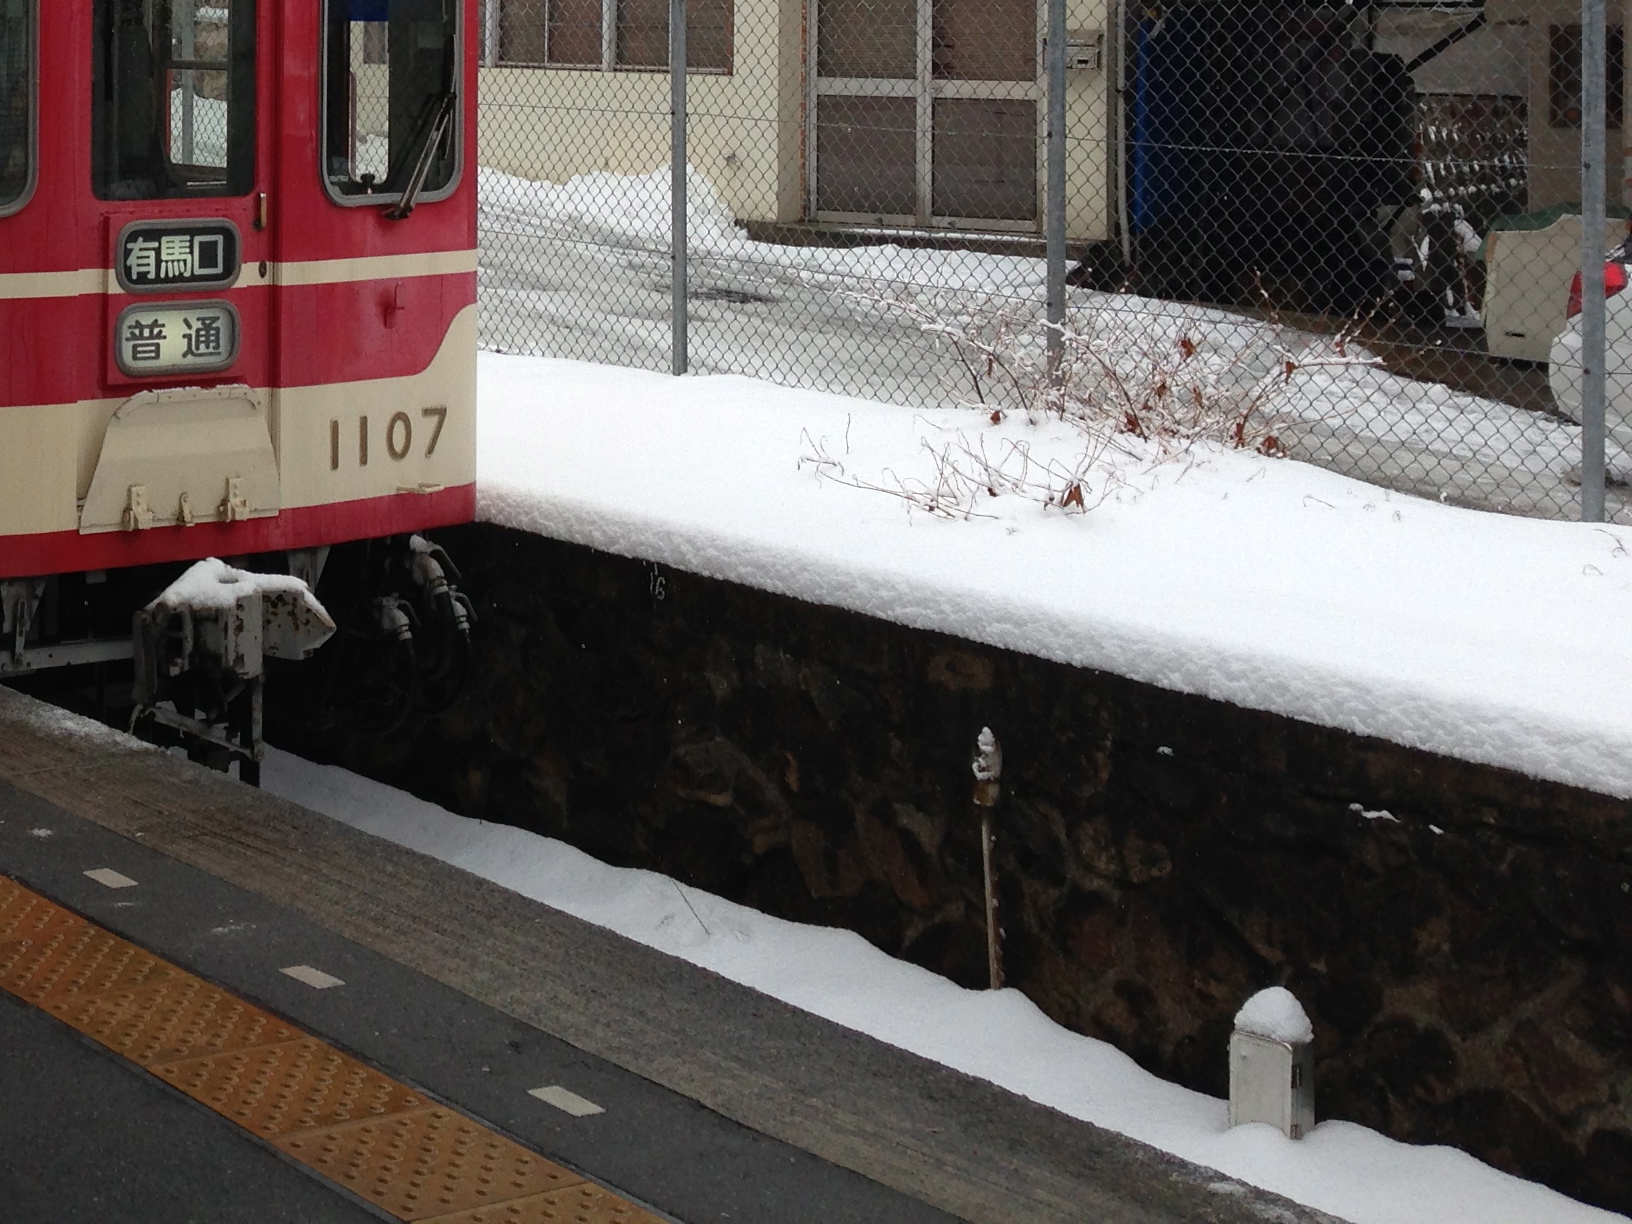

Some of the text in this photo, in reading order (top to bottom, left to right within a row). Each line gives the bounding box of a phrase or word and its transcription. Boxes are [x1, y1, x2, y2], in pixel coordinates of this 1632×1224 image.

[126, 234, 224, 280] 有馬口
[124, 315, 222, 362] 普通
[330, 406, 448, 471] 1107
